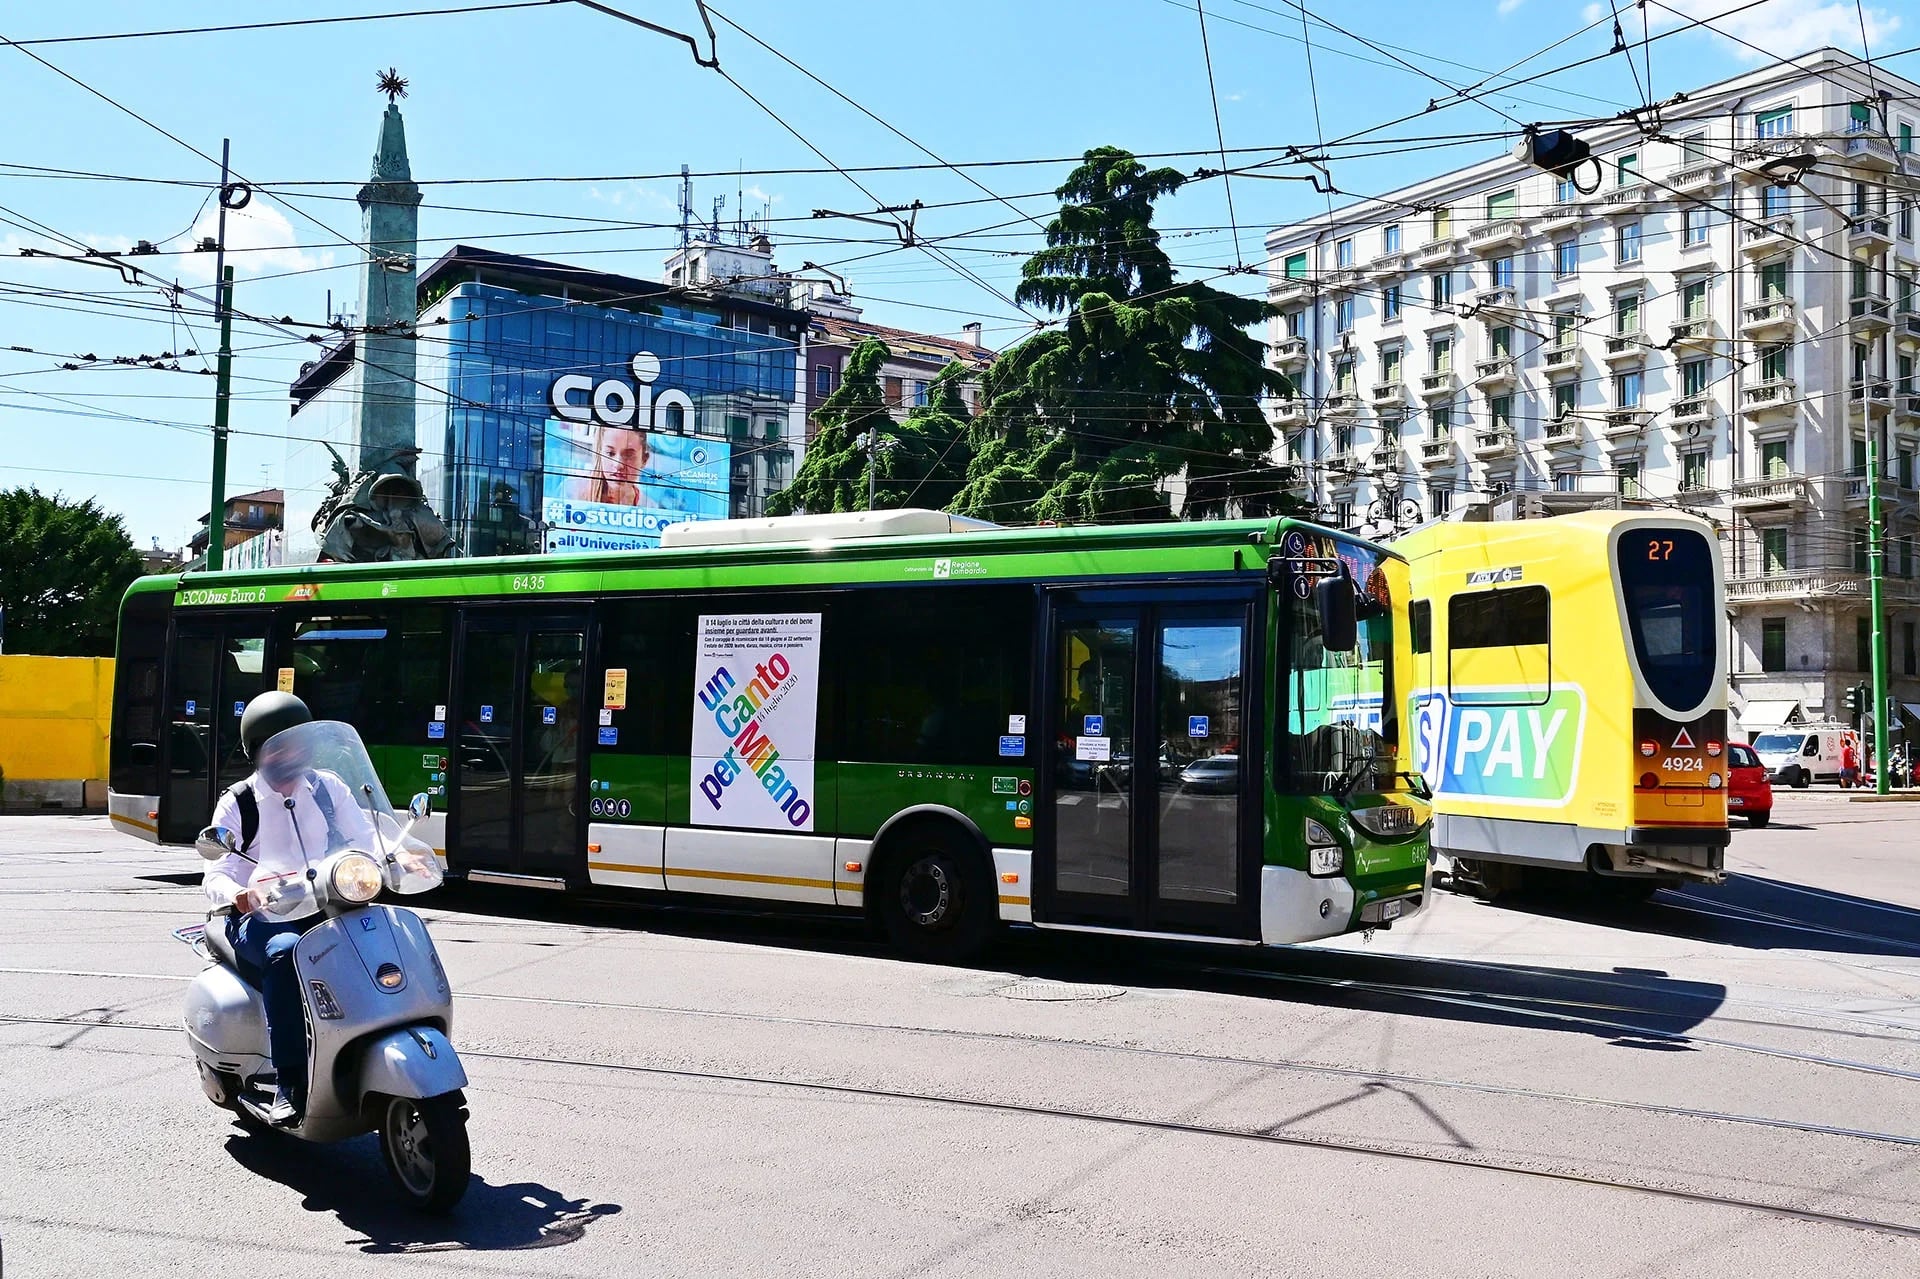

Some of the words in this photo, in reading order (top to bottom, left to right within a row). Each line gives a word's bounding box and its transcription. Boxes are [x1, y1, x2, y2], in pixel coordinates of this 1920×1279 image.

[551, 350, 696, 437] coin
[1648, 540, 1674, 560] 27
[951, 561, 980, 570] Regione
[951, 567, 987, 575] Lombardia
[513, 575, 546, 591] 6435
[181, 590, 228, 605] ECObus
[229, 588, 256, 603] Euro
[258, 587, 266, 602] 6
[704, 627, 726, 635] insieme
[725, 628, 735, 636] per
[735, 626, 760, 636] guardare
[717, 618, 731, 627] luglio
[732, 618, 737, 626] la
[738, 617, 751, 626] città
[751, 617, 765, 626] della
[765, 617, 784, 626] cultura
[790, 617, 799, 625] del
[799, 617, 813, 625] bene
[698, 666, 736, 711] un
[715, 653, 790, 738] Canto
[763, 694, 784, 715] luglio
[781, 674, 799, 696] 2020
[1452, 708, 1568, 779] PAY
[733, 719, 811, 827] Milano
[1662, 757, 1704, 772] 4924
[699, 746, 741, 811] per
